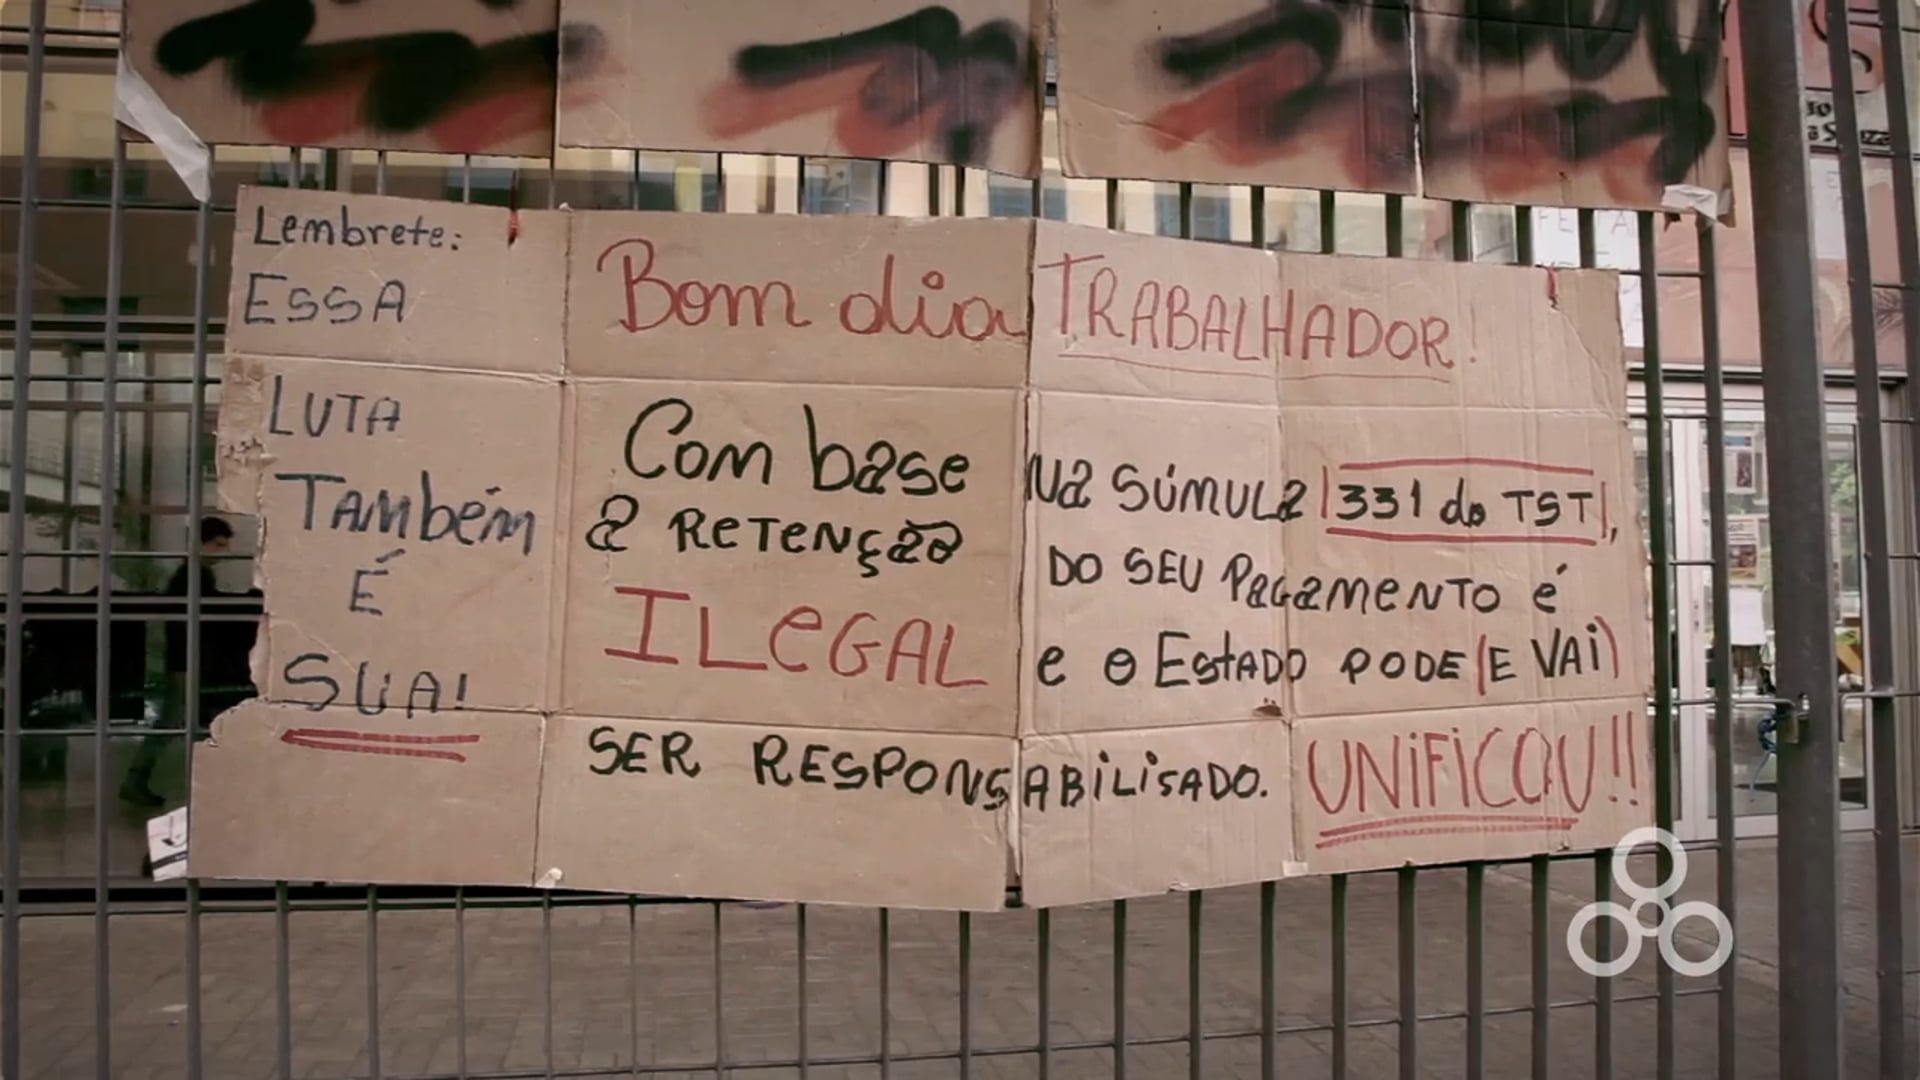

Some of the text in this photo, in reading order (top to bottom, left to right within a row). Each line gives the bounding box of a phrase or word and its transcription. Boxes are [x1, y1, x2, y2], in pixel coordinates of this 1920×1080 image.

[254, 205, 462, 251] Lembrete:
[243, 273, 406, 325] ESSA
[597, 238, 1478, 370] Bom dia TRABALHADOR!
[268, 375, 401, 437] LUTA
[623, 398, 773, 486] Com
[803, 403, 971, 496] base
[1440, 477, 1487, 529] do
[349, 548, 406, 616] É
[585, 493, 639, 552] a
[1049, 545, 1103, 587] DO
[1123, 546, 1203, 593] SEU
[1532, 563, 1568, 614] é
[283, 653, 468, 719] SUA!
[1339, 646, 1468, 684] PODE
[588, 726, 701, 778] SER
